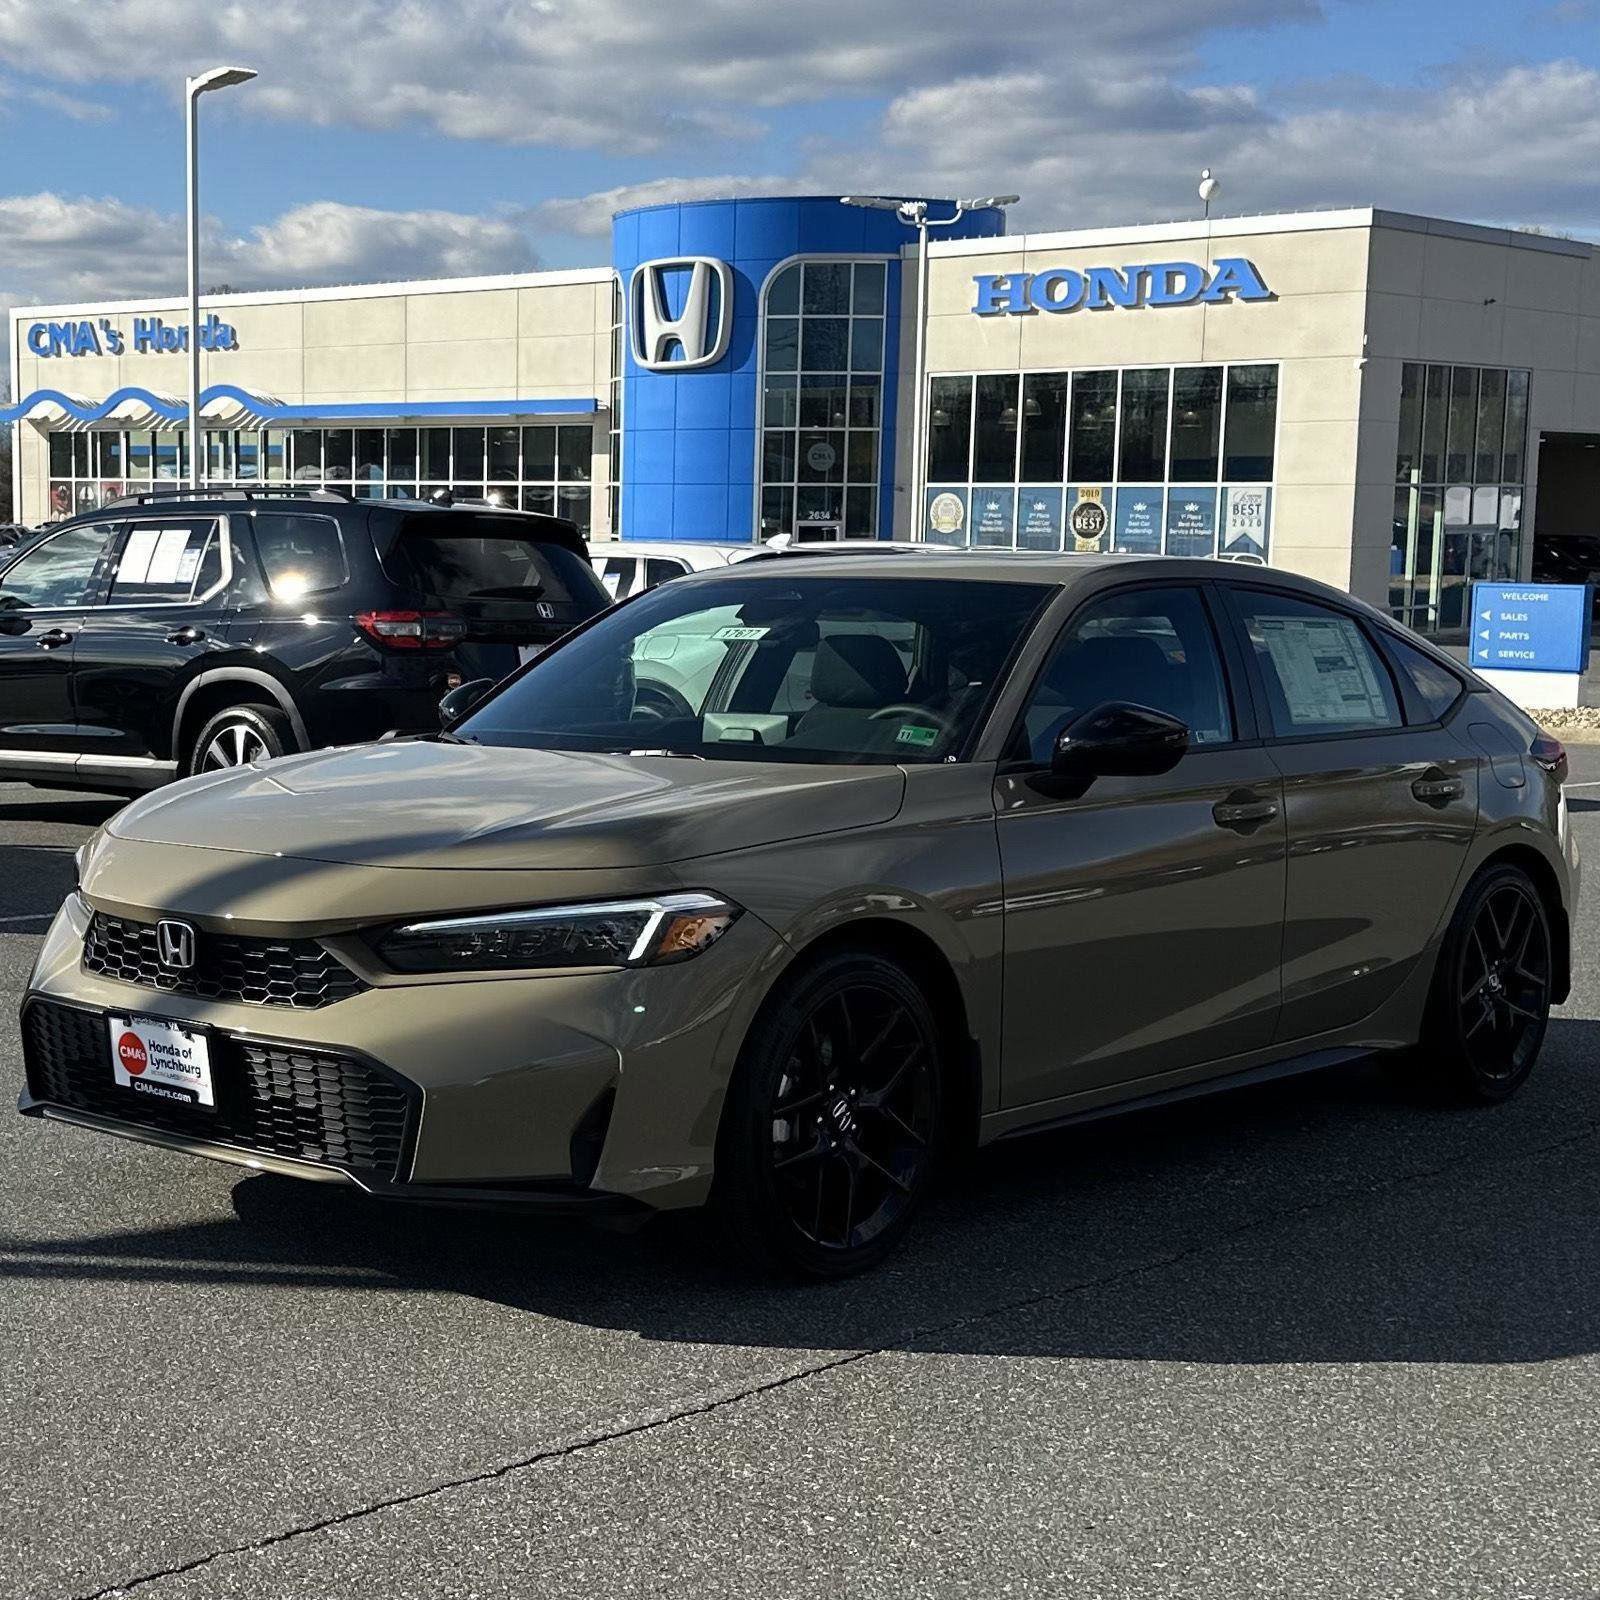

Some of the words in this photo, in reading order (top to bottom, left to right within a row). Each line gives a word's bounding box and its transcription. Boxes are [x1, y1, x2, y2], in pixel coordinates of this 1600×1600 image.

[970, 258, 1275, 317] HONDA
[27, 319, 123, 357] CMA's
[1232, 503, 1262, 515] BEST
[1075, 517, 1102, 530] BEST
[1232, 519, 1262, 527] 2020
[1501, 592, 1549, 602] WELCOME
[1500, 612, 1529, 622] SALES
[1499, 631, 1530, 641] PARTS
[1497, 649, 1536, 660] SERVICE
[119, 1045, 147, 1061] CMA's
[148, 1039, 180, 1057] Honda
[181, 1048, 193, 1060] of
[150, 1053, 202, 1079] Lynchburg
[134, 1081, 192, 1103] CMAcars.com
